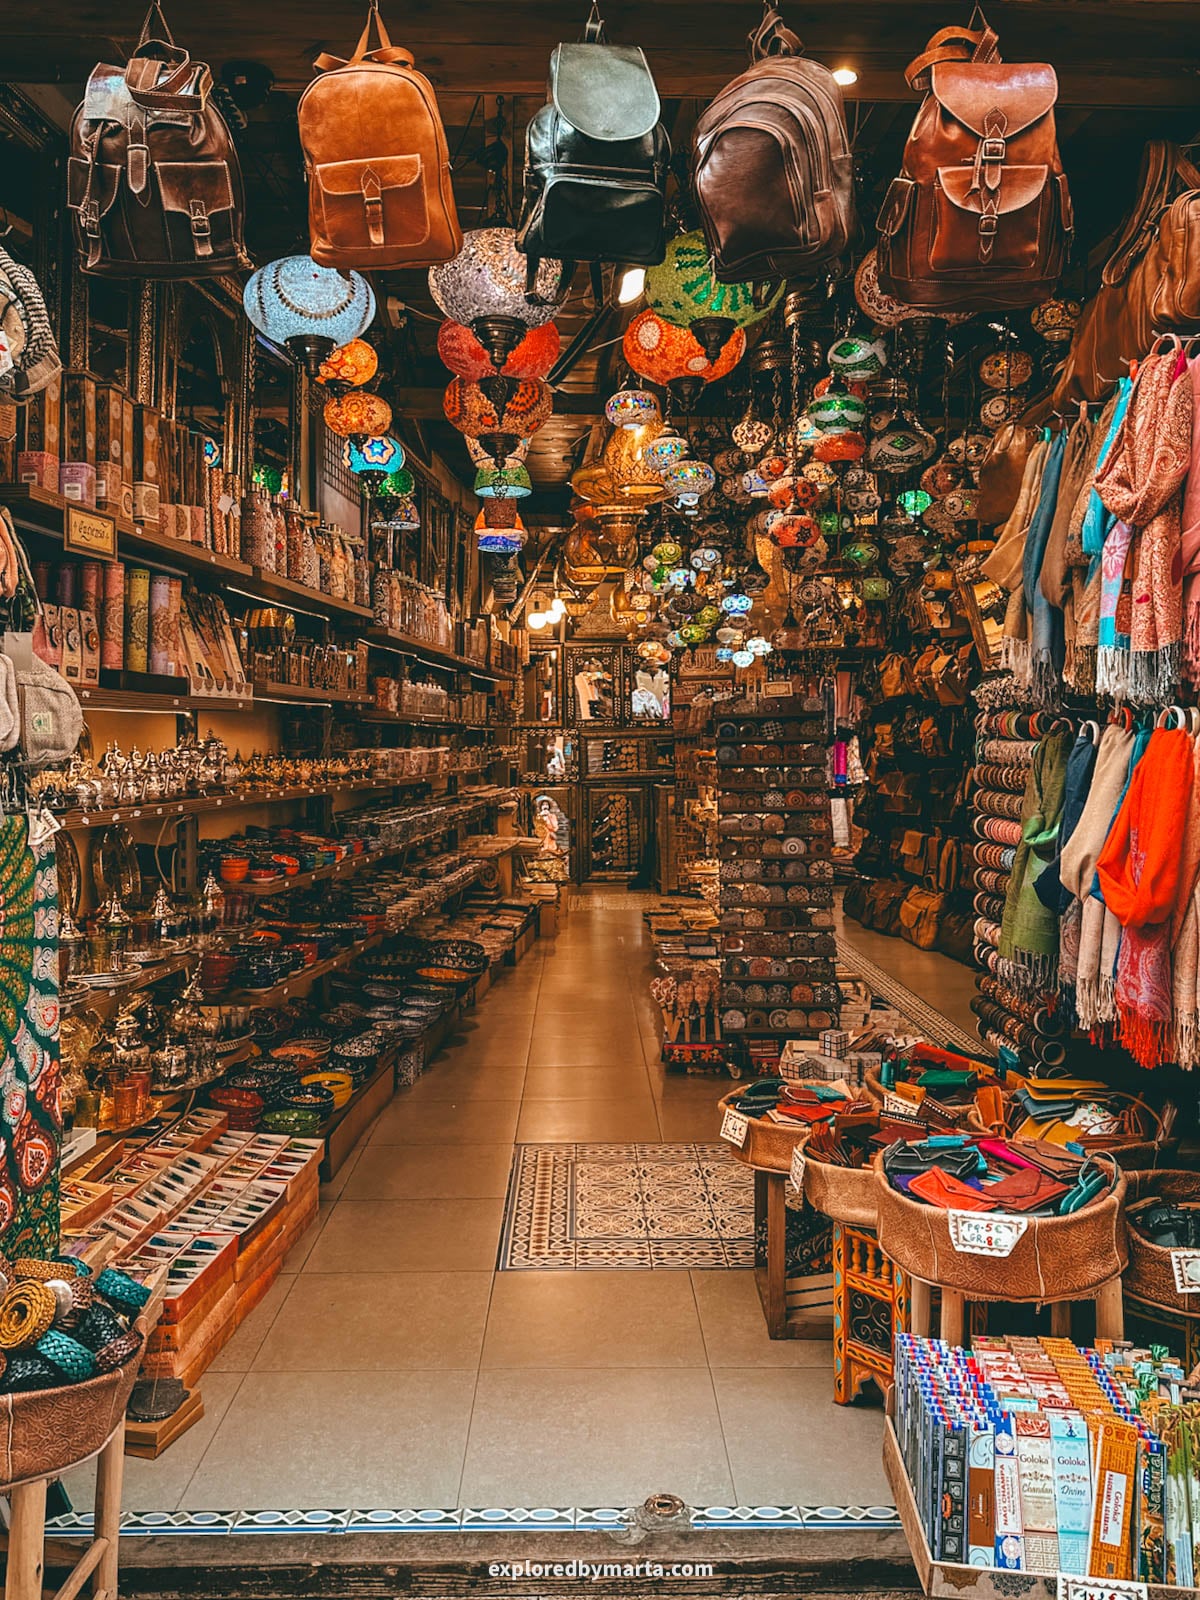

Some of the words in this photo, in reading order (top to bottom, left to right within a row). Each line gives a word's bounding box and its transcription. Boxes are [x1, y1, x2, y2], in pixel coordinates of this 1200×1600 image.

[1020, 1453, 1049, 1464] Goloka
[1057, 1455, 1086, 1466] Goloka
[1022, 1481, 1052, 1494] Chandan
[1061, 1485, 1086, 1496] Divine
[1148, 1453, 1161, 1516] Natural
[1112, 1491, 1122, 1522] Goloka
